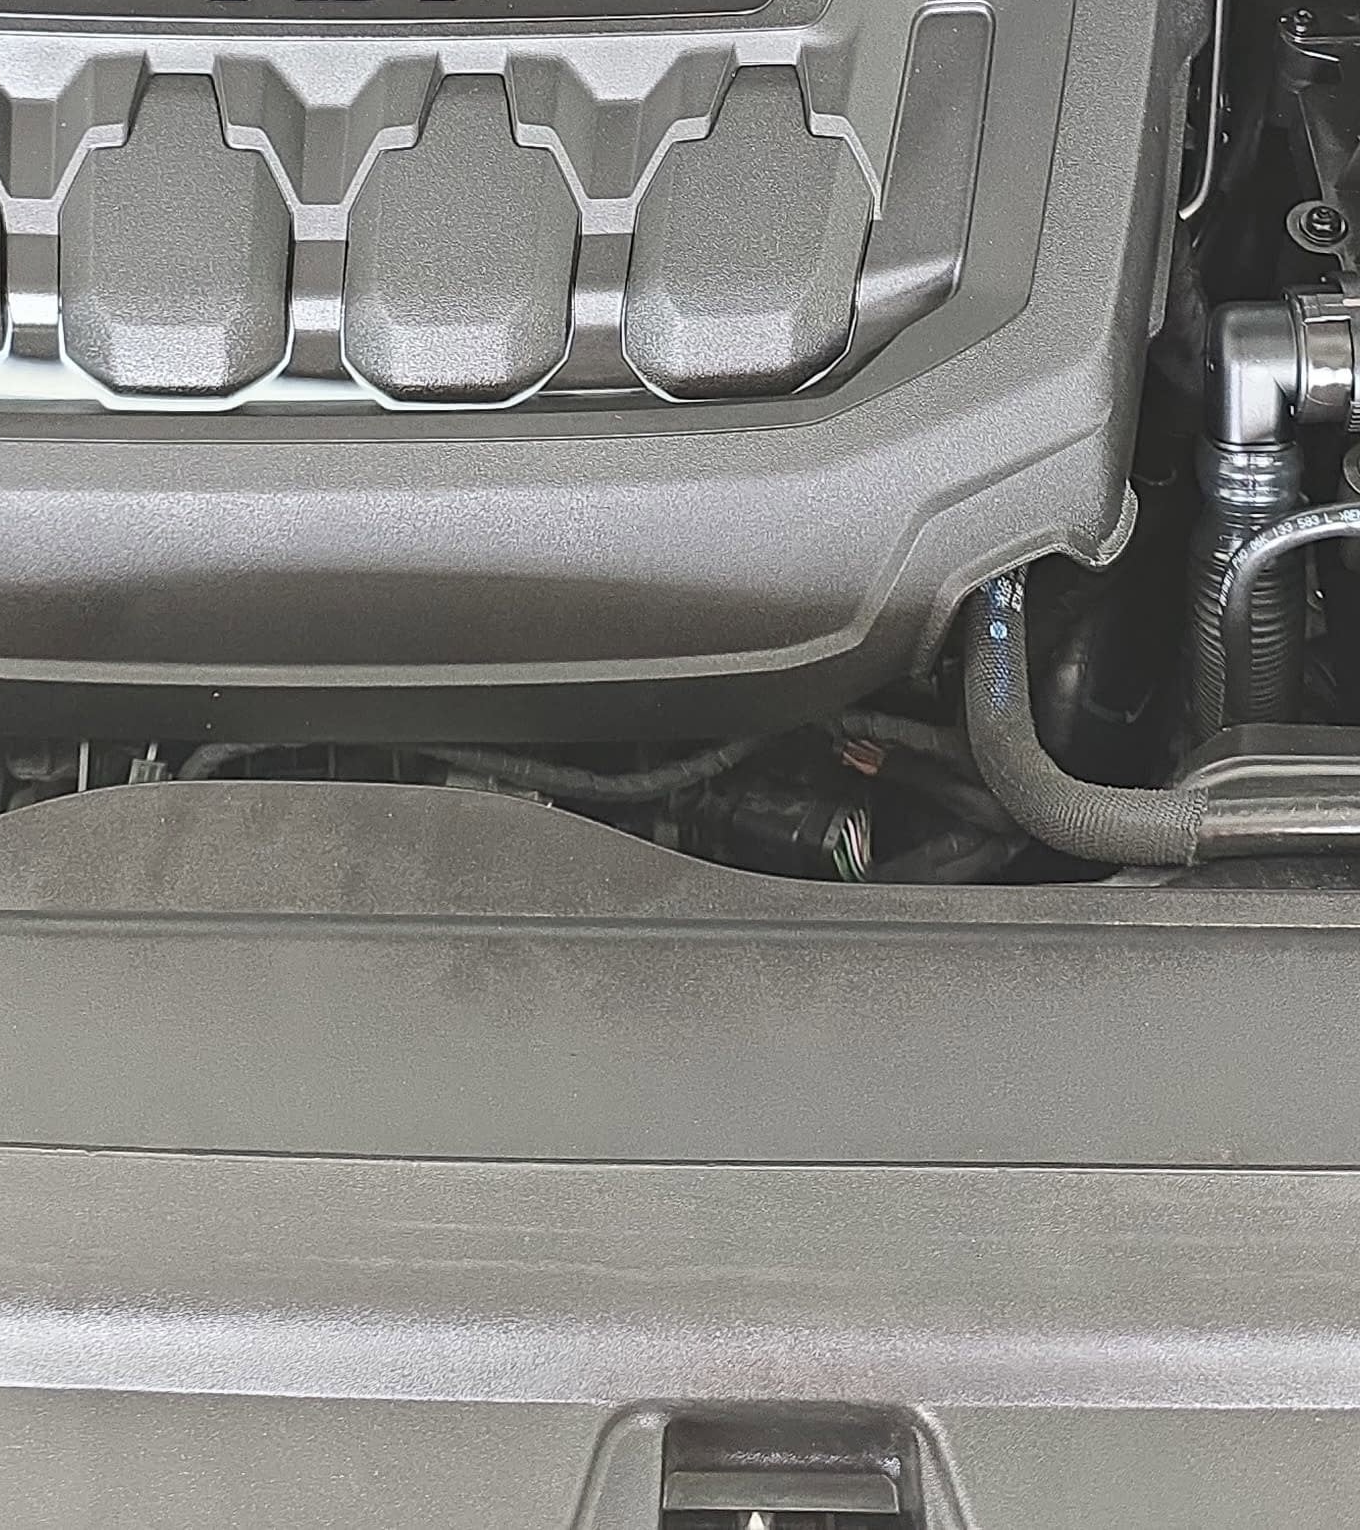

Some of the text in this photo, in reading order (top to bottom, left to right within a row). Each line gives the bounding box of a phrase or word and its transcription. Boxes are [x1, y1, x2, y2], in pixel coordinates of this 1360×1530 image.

[1272, 521, 1294, 538] 133
[1296, 514, 1321, 530] 583
[1323, 512, 1333, 524] L
